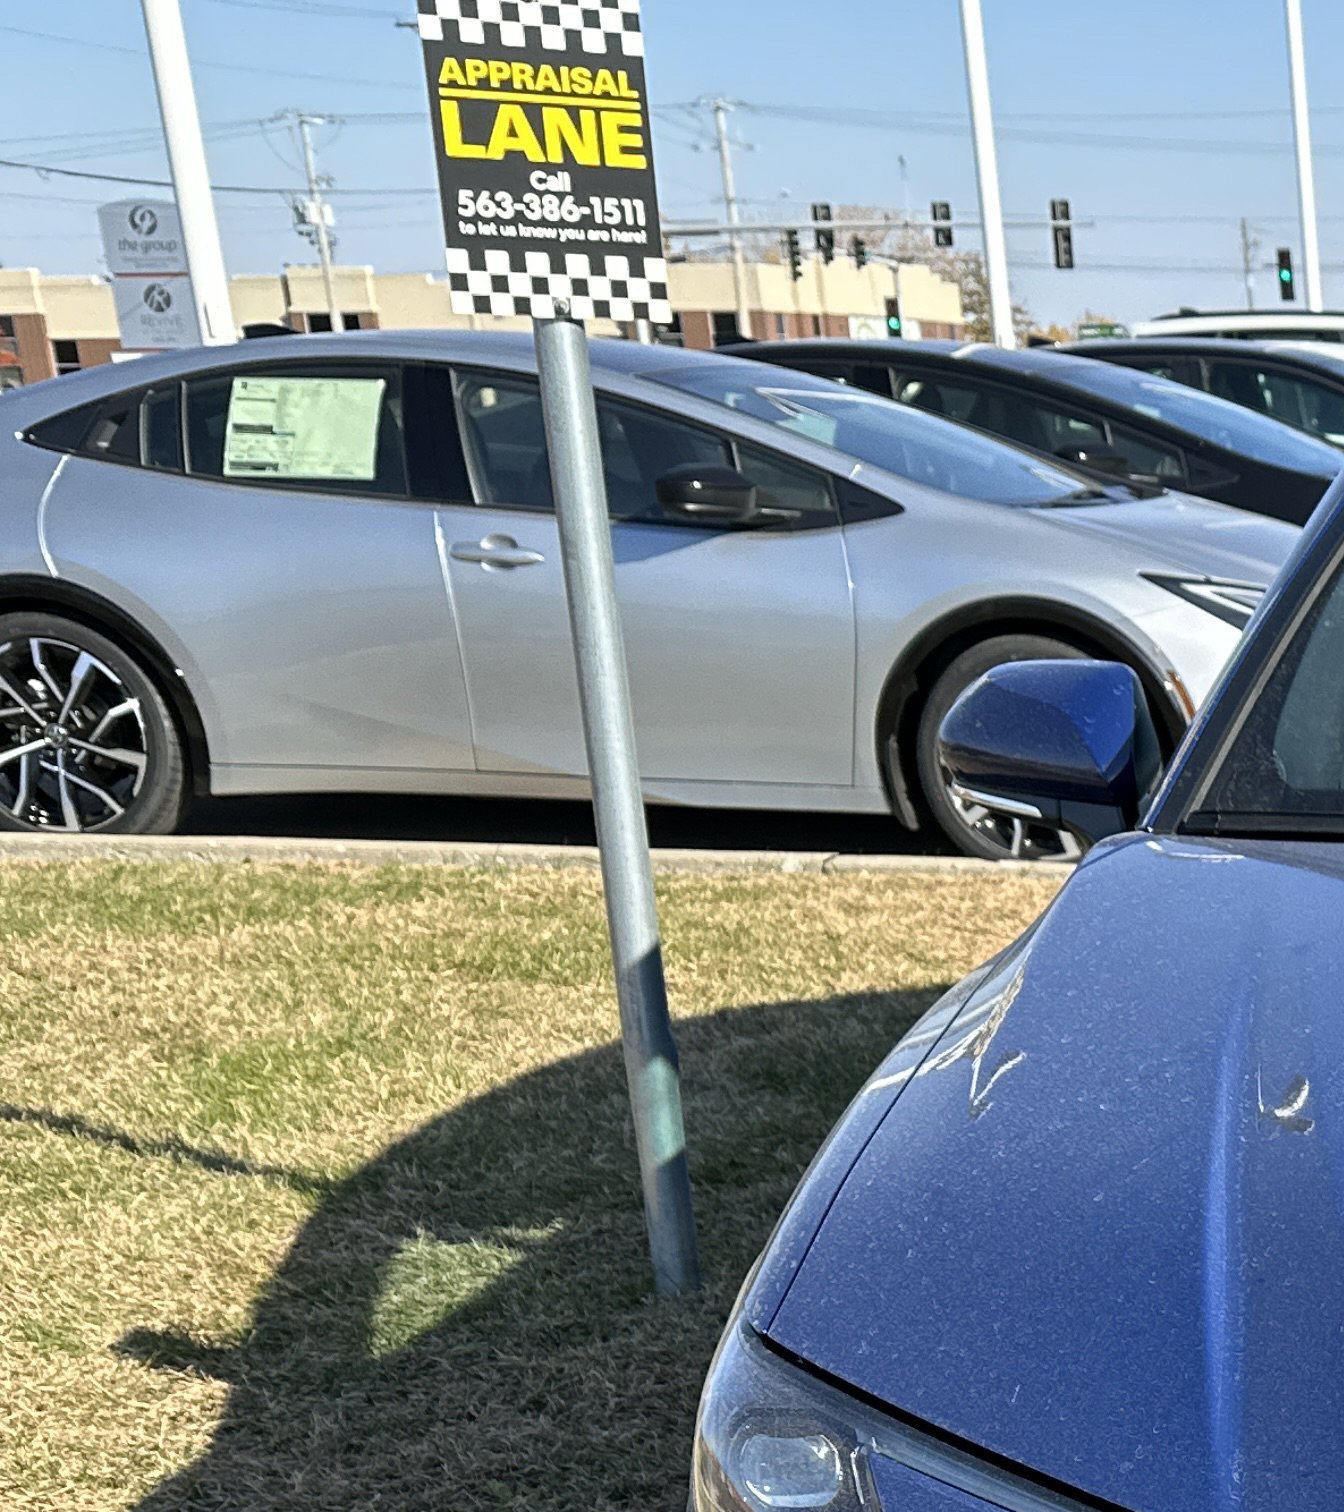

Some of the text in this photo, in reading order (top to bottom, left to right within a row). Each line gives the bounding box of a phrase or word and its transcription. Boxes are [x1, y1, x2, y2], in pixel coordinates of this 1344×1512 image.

[438, 57, 640, 99] APPRAISAL
[440, 99, 648, 170] LANE
[529, 170, 572, 193] Call
[457, 189, 646, 227] 563-386-1511
[118, 238, 177, 254] the group
[458, 221, 648, 244] to let us know you are here!
